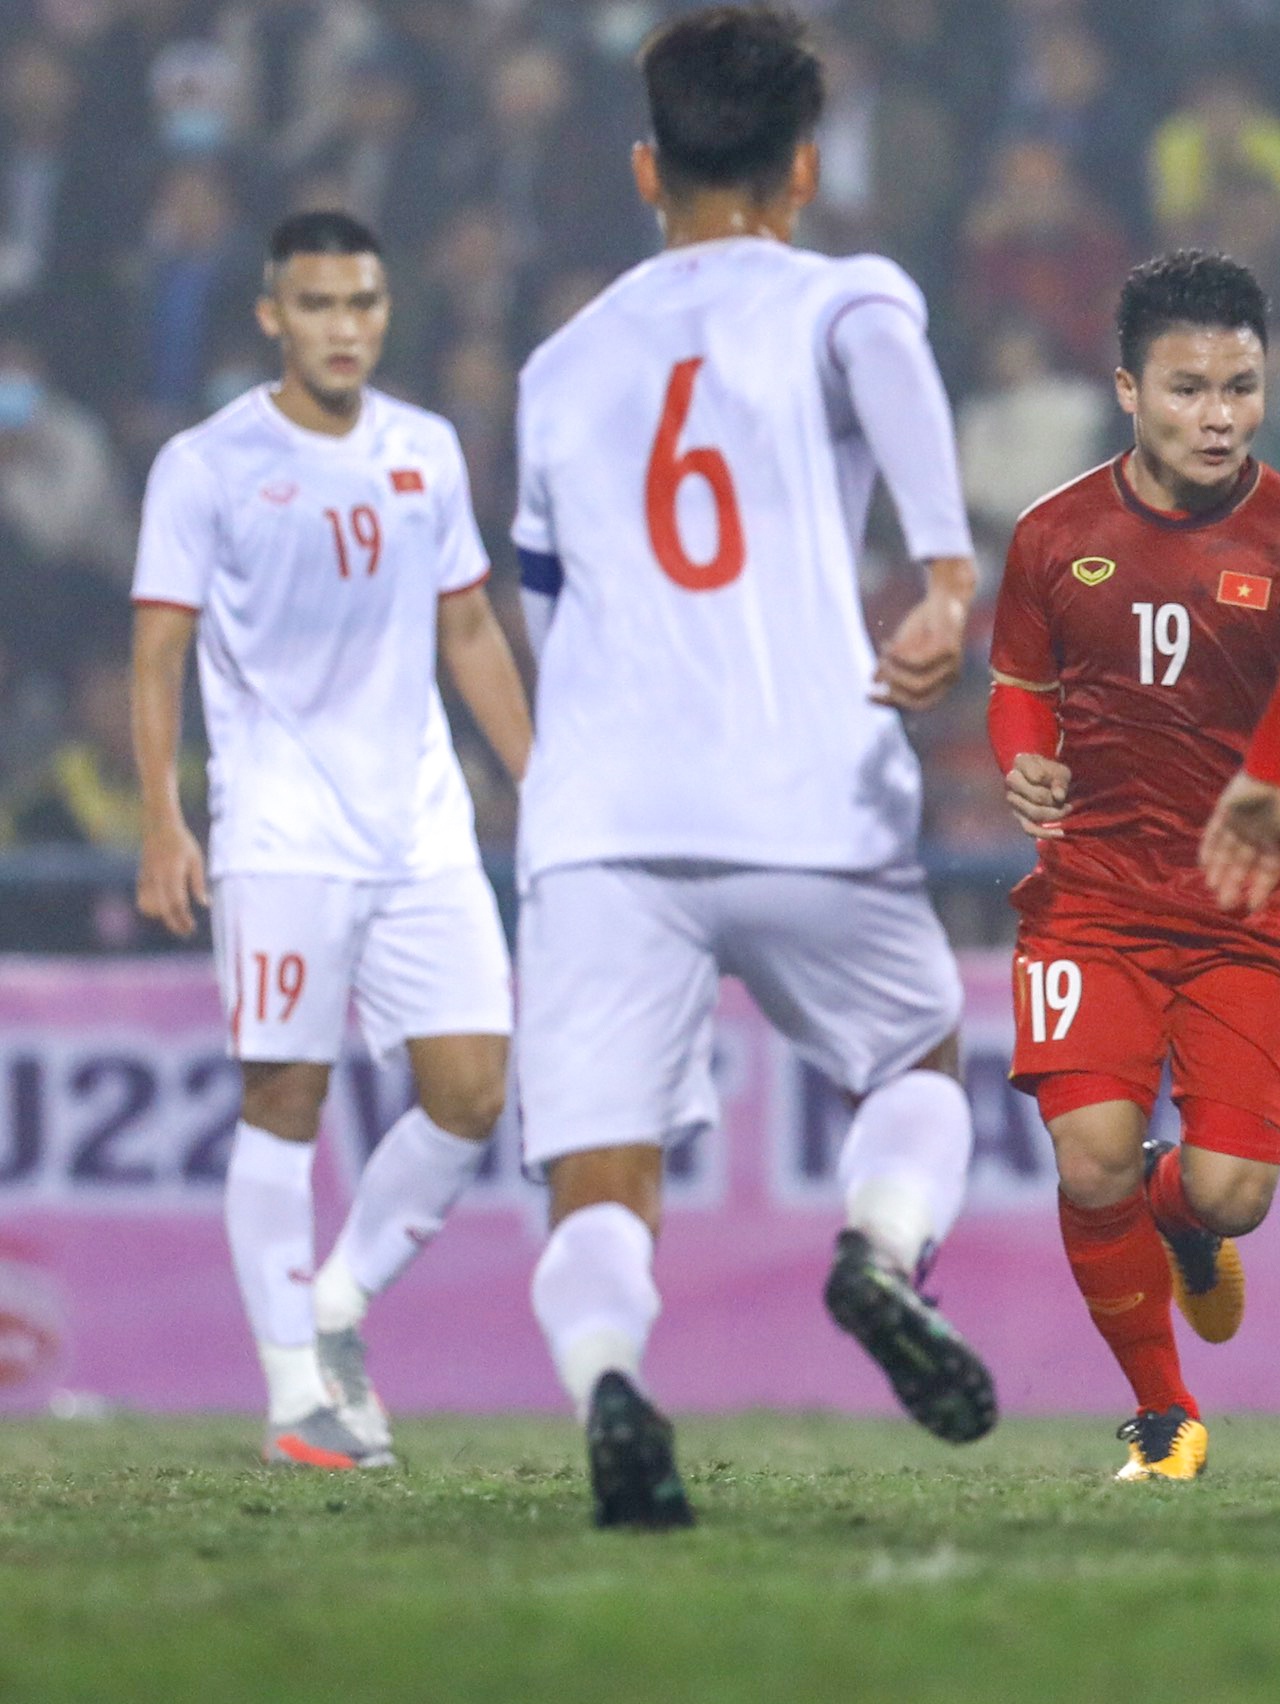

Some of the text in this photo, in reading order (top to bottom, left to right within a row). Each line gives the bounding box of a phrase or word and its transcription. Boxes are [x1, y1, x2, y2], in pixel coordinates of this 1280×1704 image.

[645, 356, 747, 590] 6
[324, 504, 382, 578] 19
[1131, 602, 1190, 686] 19
[253, 951, 306, 1023] 19
[1026, 959, 1083, 1043] 19
